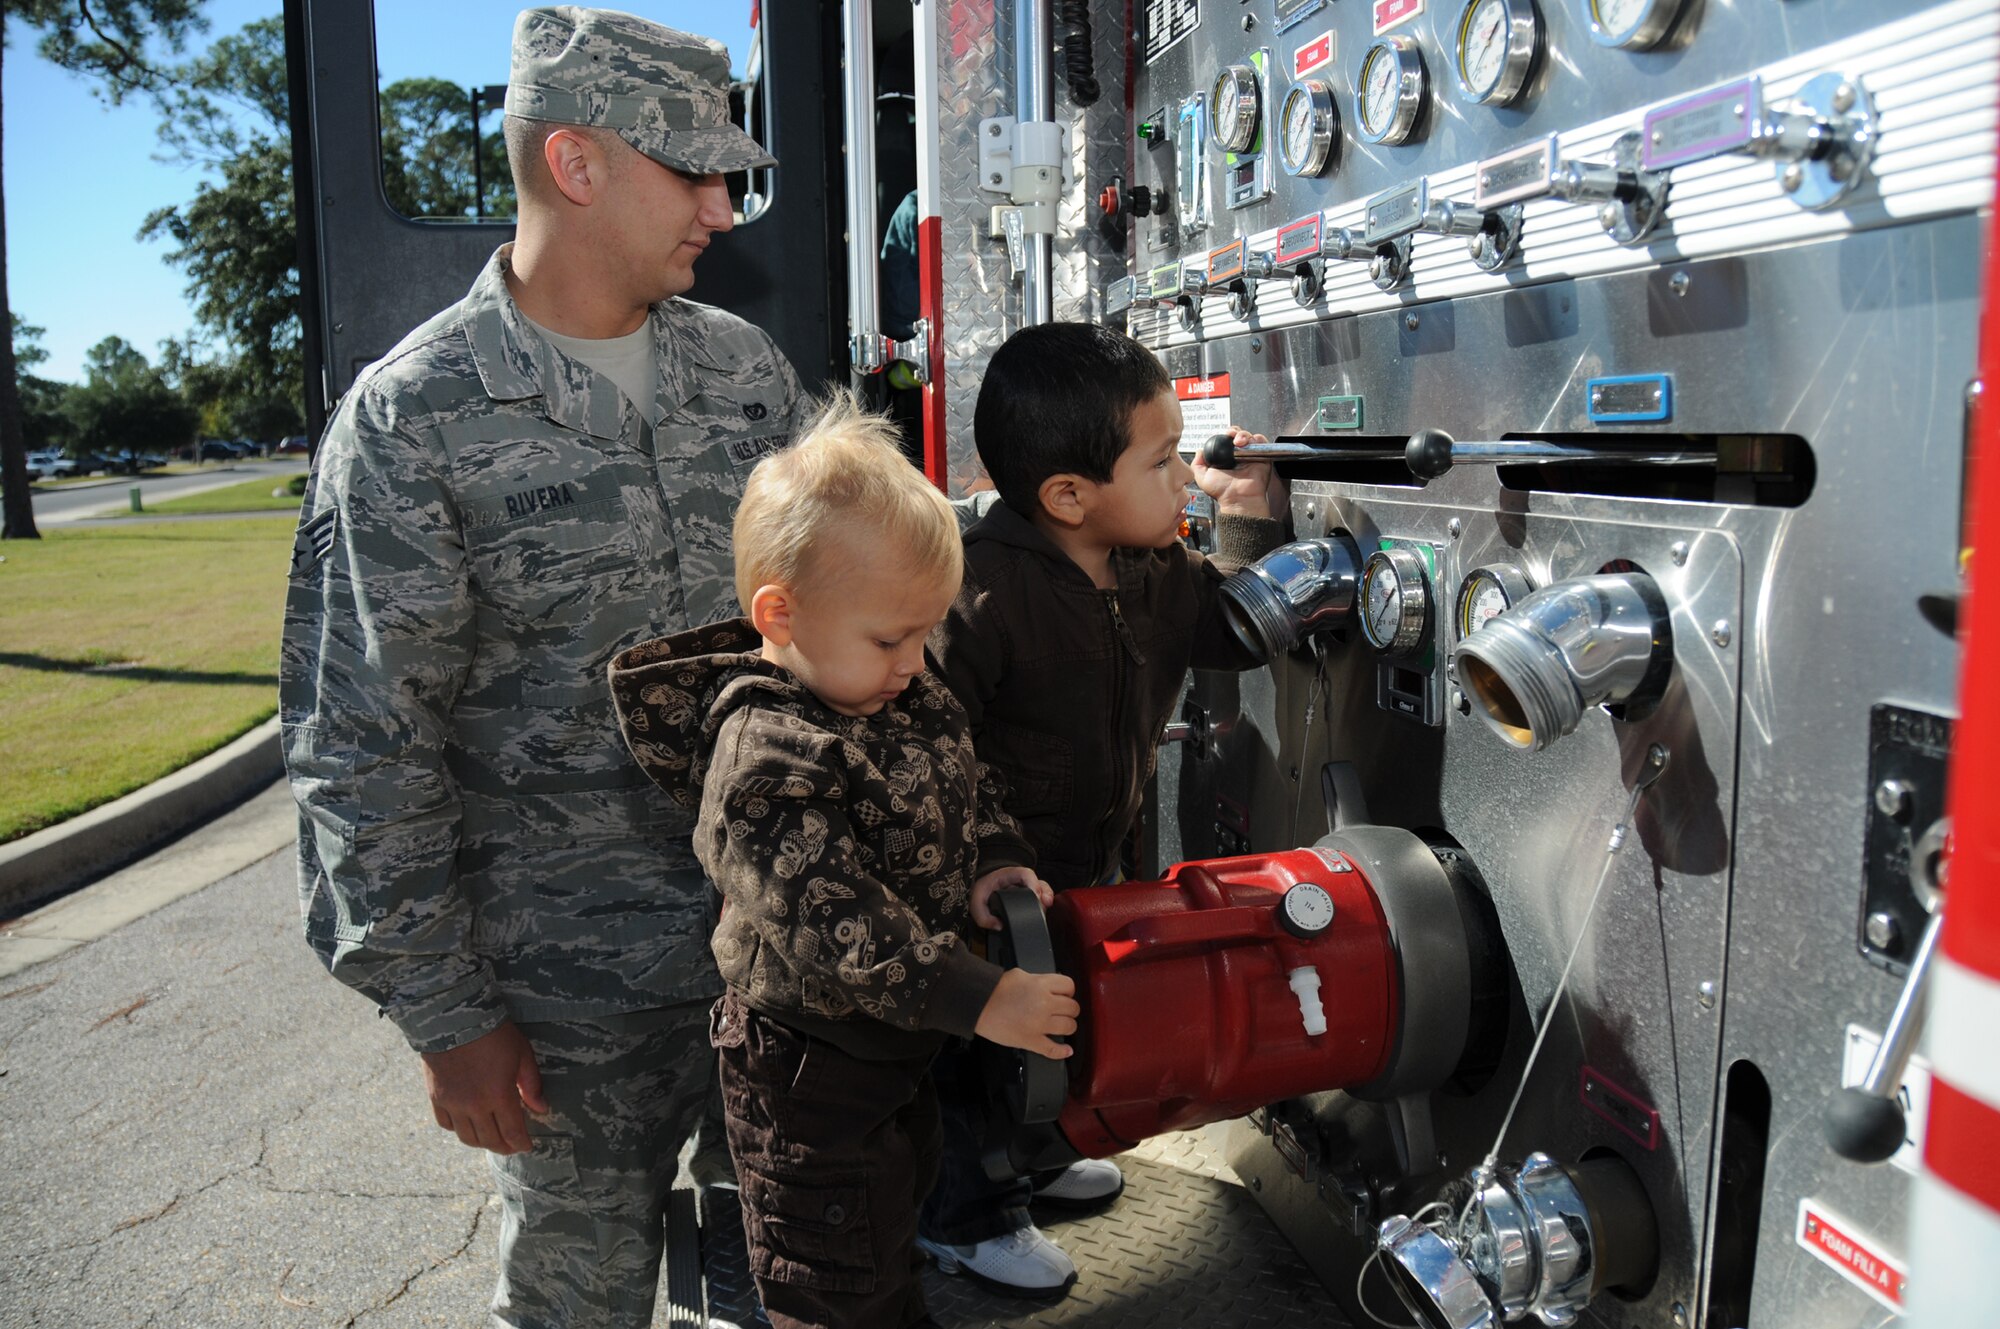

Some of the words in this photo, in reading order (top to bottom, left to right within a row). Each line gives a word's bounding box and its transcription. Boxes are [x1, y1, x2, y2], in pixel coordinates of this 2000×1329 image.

[1306, 49, 1319, 63] FOAM
[1193, 381, 1215, 394] DANGER
[504, 483, 575, 519] RIVERA
[1299, 886, 1320, 895] DRAIN
[1320, 893, 1332, 913] VALVE
[1304, 901, 1315, 912] 114
[1820, 1228, 1852, 1263] FOAM
[1852, 1251, 1878, 1281] FILL
[1878, 1269, 1889, 1288] A
